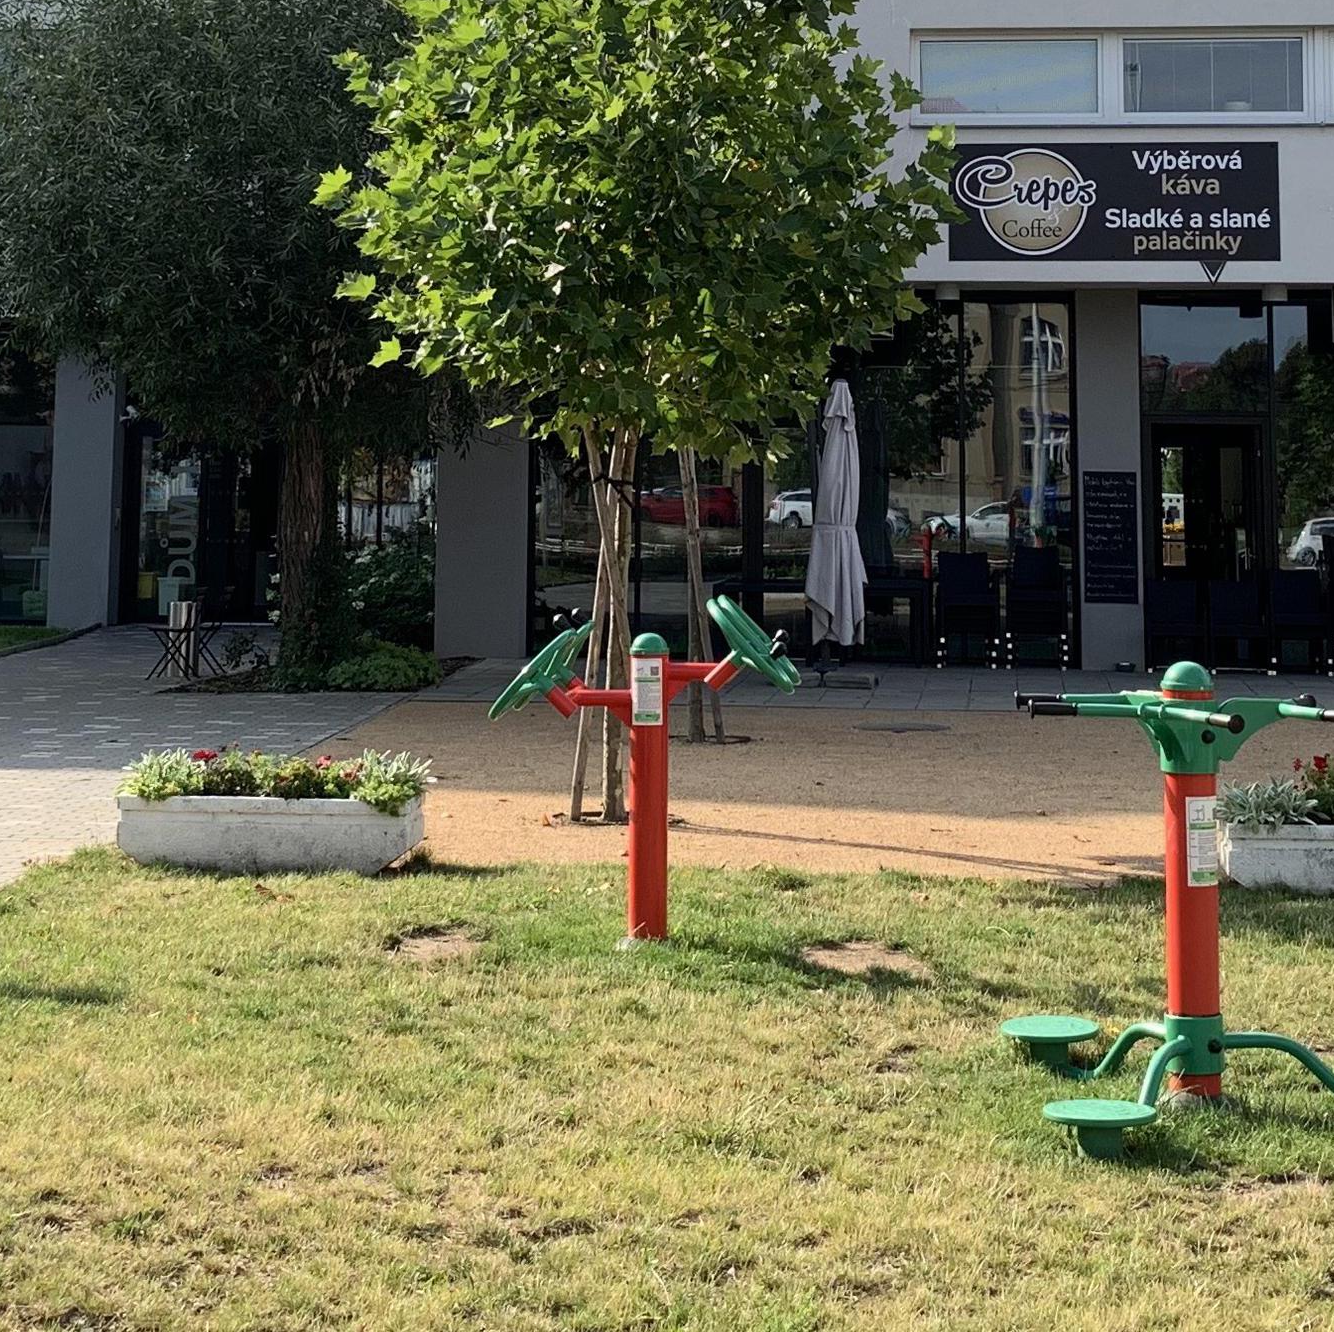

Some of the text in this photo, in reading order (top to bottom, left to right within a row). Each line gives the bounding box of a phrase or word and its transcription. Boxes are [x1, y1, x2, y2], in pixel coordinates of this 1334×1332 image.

[1131, 150, 1242, 175] Výběrová
[955, 155, 1097, 212] Crepes
[1161, 173, 1220, 195] káva
[1001, 218, 1062, 239] Coffee
[1104, 208, 1271, 229] Sladké a slané
[1133, 230, 1242, 254] palačinky
